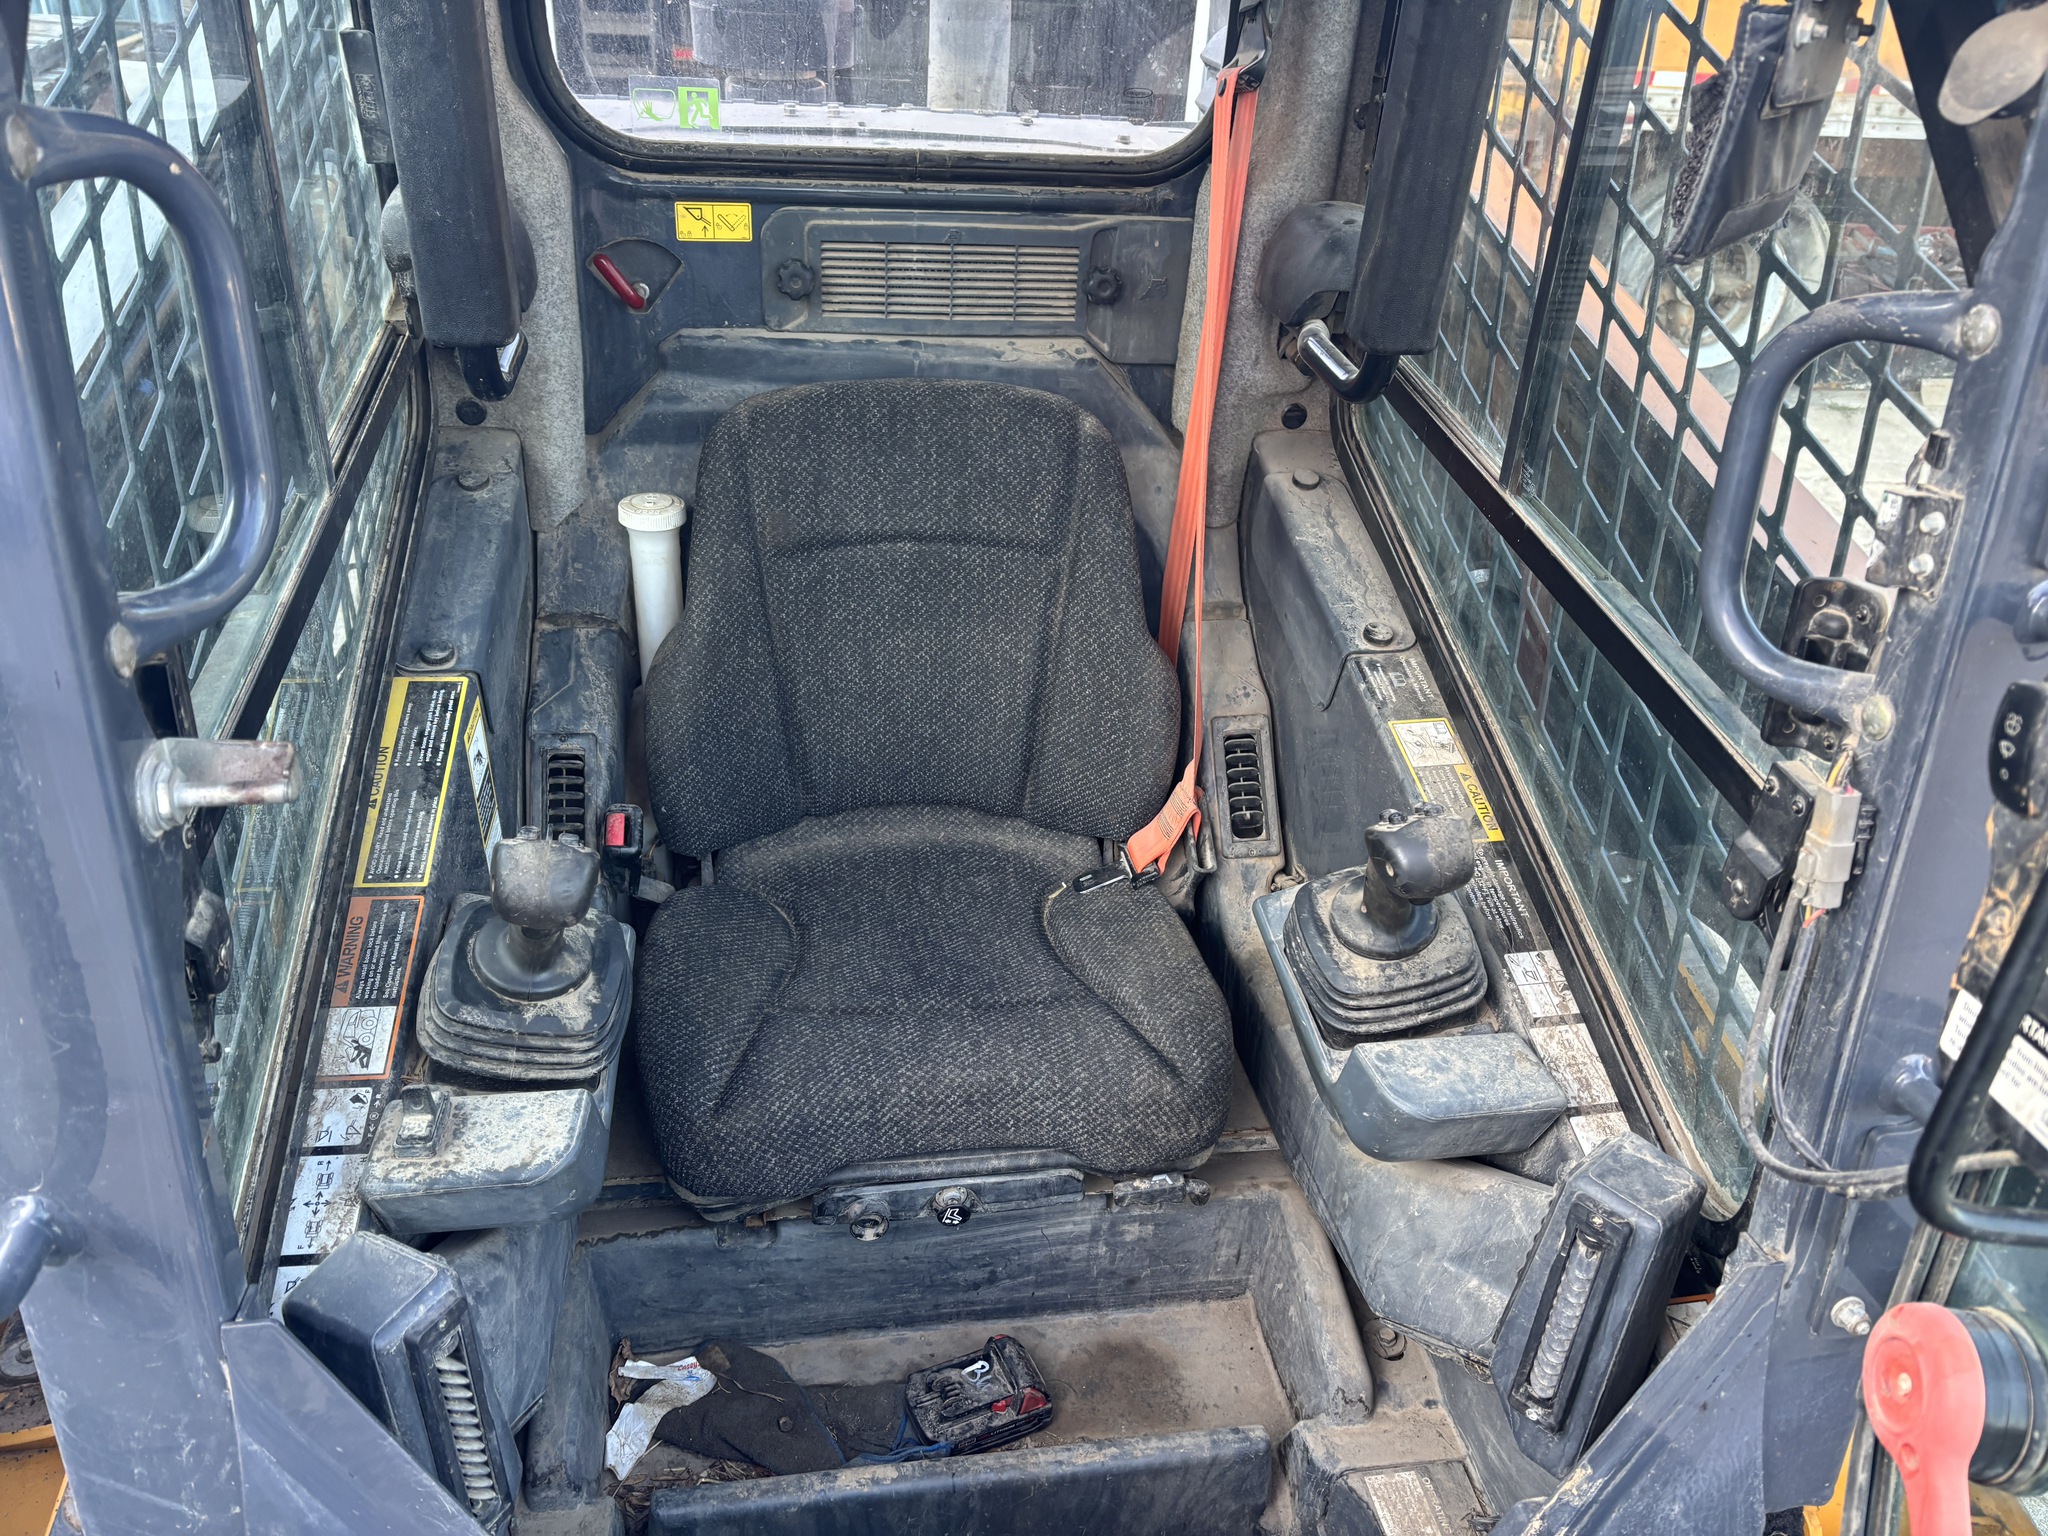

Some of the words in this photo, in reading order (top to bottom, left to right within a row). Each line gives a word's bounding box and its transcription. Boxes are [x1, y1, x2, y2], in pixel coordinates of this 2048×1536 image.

[1408, 658, 1435, 699] IMPORTANT
[371, 746, 390, 794] CAUTION
[383, 793, 391, 817] understand
[390, 798, 398, 818] operating
[1467, 783, 1498, 831] CAUTION
[1481, 901, 1493, 921] before
[1489, 887, 1511, 927] temperatures
[1495, 859, 1530, 919] IMPORTANT
[337, 916, 364, 978] WARNING
[1507, 908, 1524, 940] hydraulics
[355, 981, 364, 999] Always
[369, 921, 377, 936] before
[365, 978, 373, 999] working
[378, 914, 386, 934] machine
[386, 961, 395, 987] Operator's
[397, 911, 406, 933] complete
